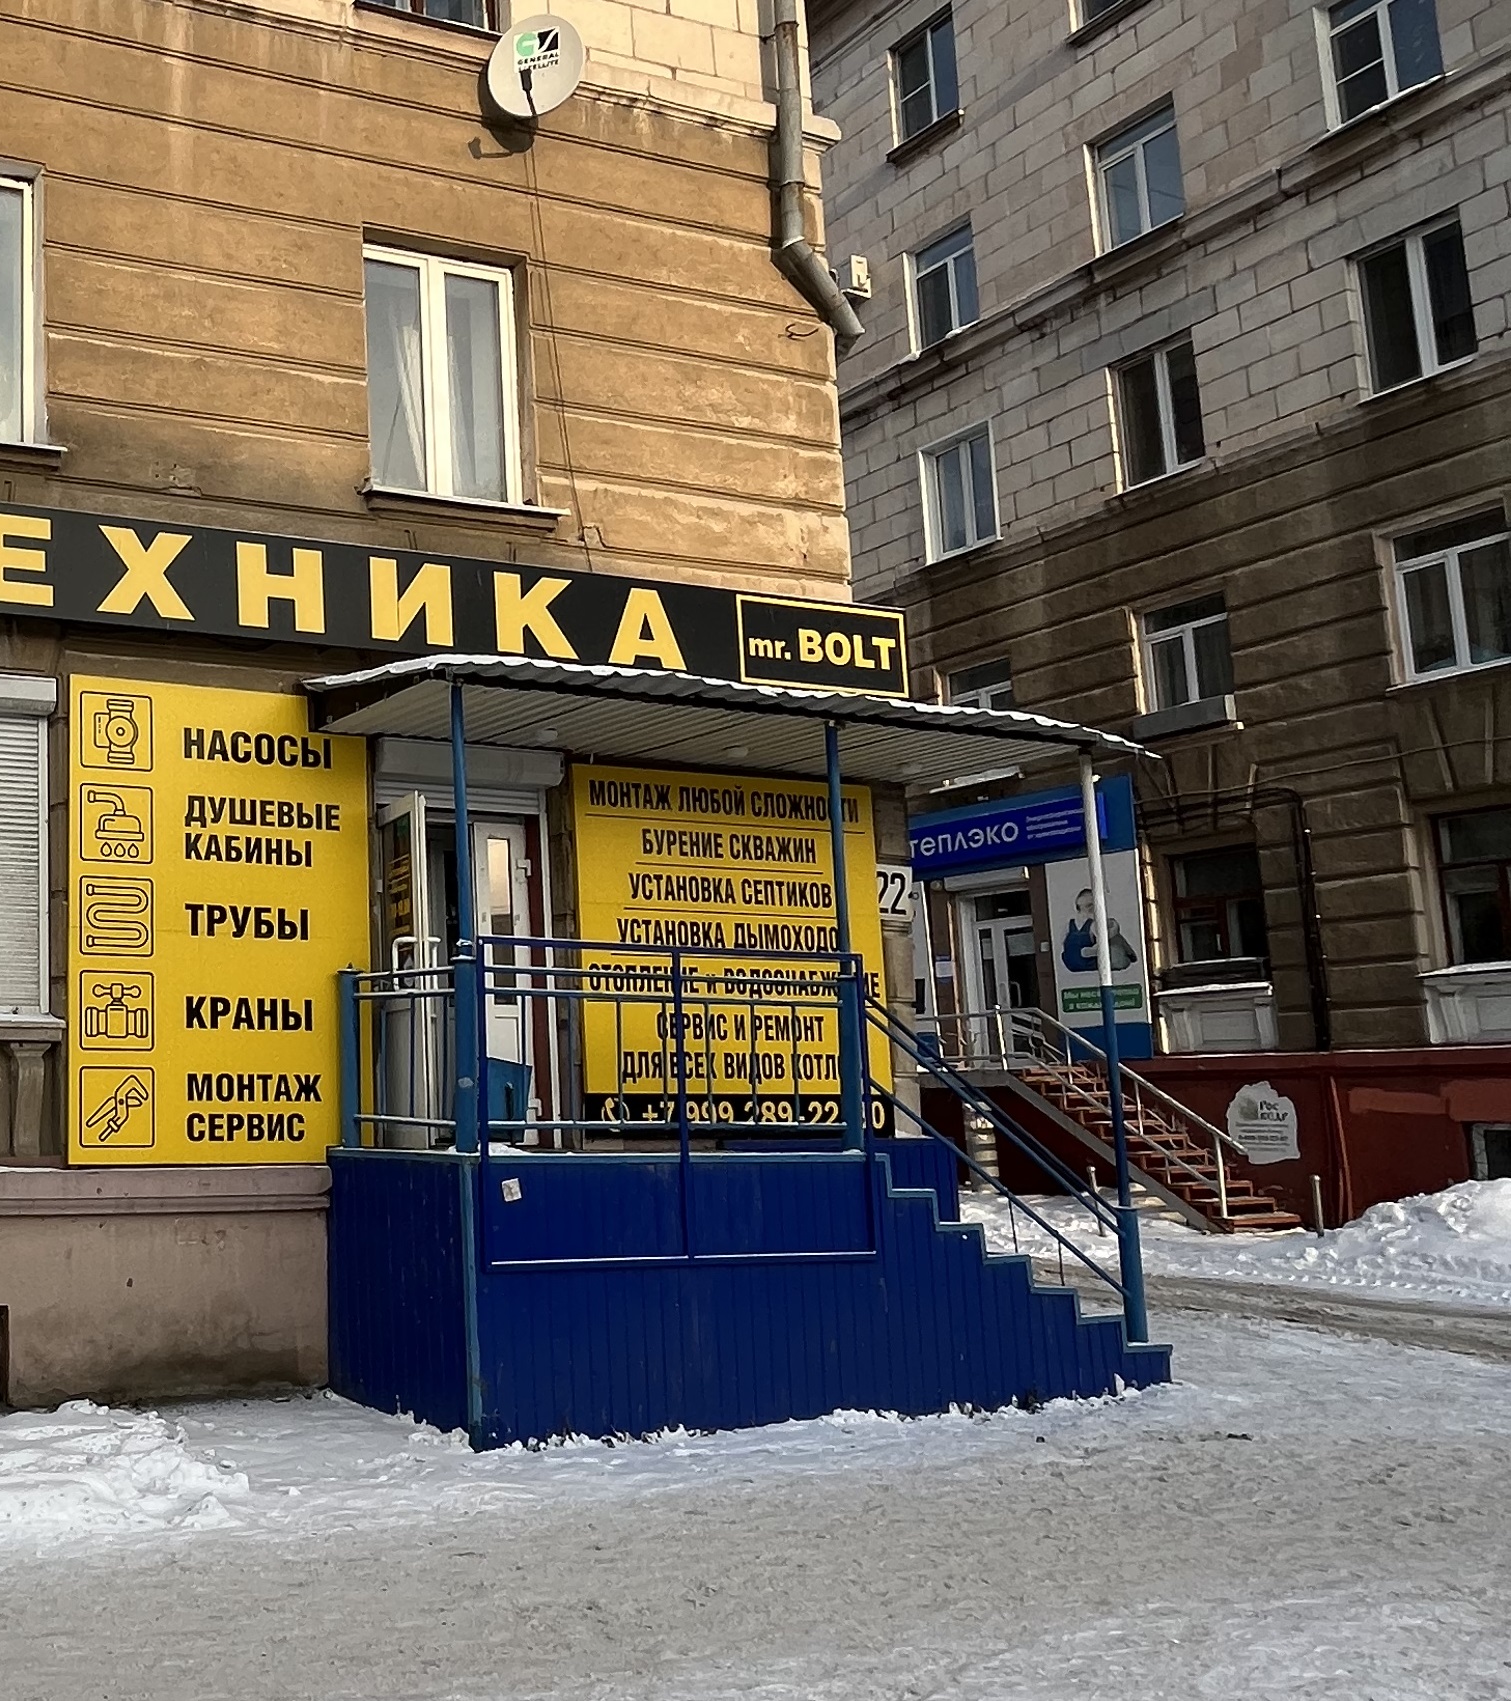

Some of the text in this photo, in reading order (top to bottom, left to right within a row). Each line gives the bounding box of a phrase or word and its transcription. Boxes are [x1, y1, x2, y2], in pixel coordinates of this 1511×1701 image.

[517, 52, 559, 66] GENERAL
[748, 627, 897, 671] mr. BOLT
[183, 727, 332, 769] НАСОСЫ
[184, 795, 340, 831] ДУШЕВЫЕ
[588, 779, 859, 823] МОНТАЖ ЛЮБОЙ СЛОЖНОТИ
[184, 833, 313, 867] КАБИНЫ
[642, 828, 817, 864] БУРЕНИЕ СКВАЖИН
[629, 873, 833, 909] УСТАНОВКА СЕПТИКОВ
[185, 903, 309, 941] ТРУБЫ
[617, 918, 839, 952] УСТАНОВКА ДЫМОХОДО
[723, 967, 881, 999] ВОДОСНАБЖЕ
[185, 996, 313, 1031] КРАНЫ
[656, 1012, 824, 1042] СЕРВИС И РЕМОНТ
[622, 1051, 840, 1085] ДЛЯ ВСЕХ ВИДОВ КОТЛ
[187, 1073, 322, 1102] МОНТАЖ
[186, 1113, 306, 1142] СЕРВИС
[686, 1101, 735, 1123] 999
